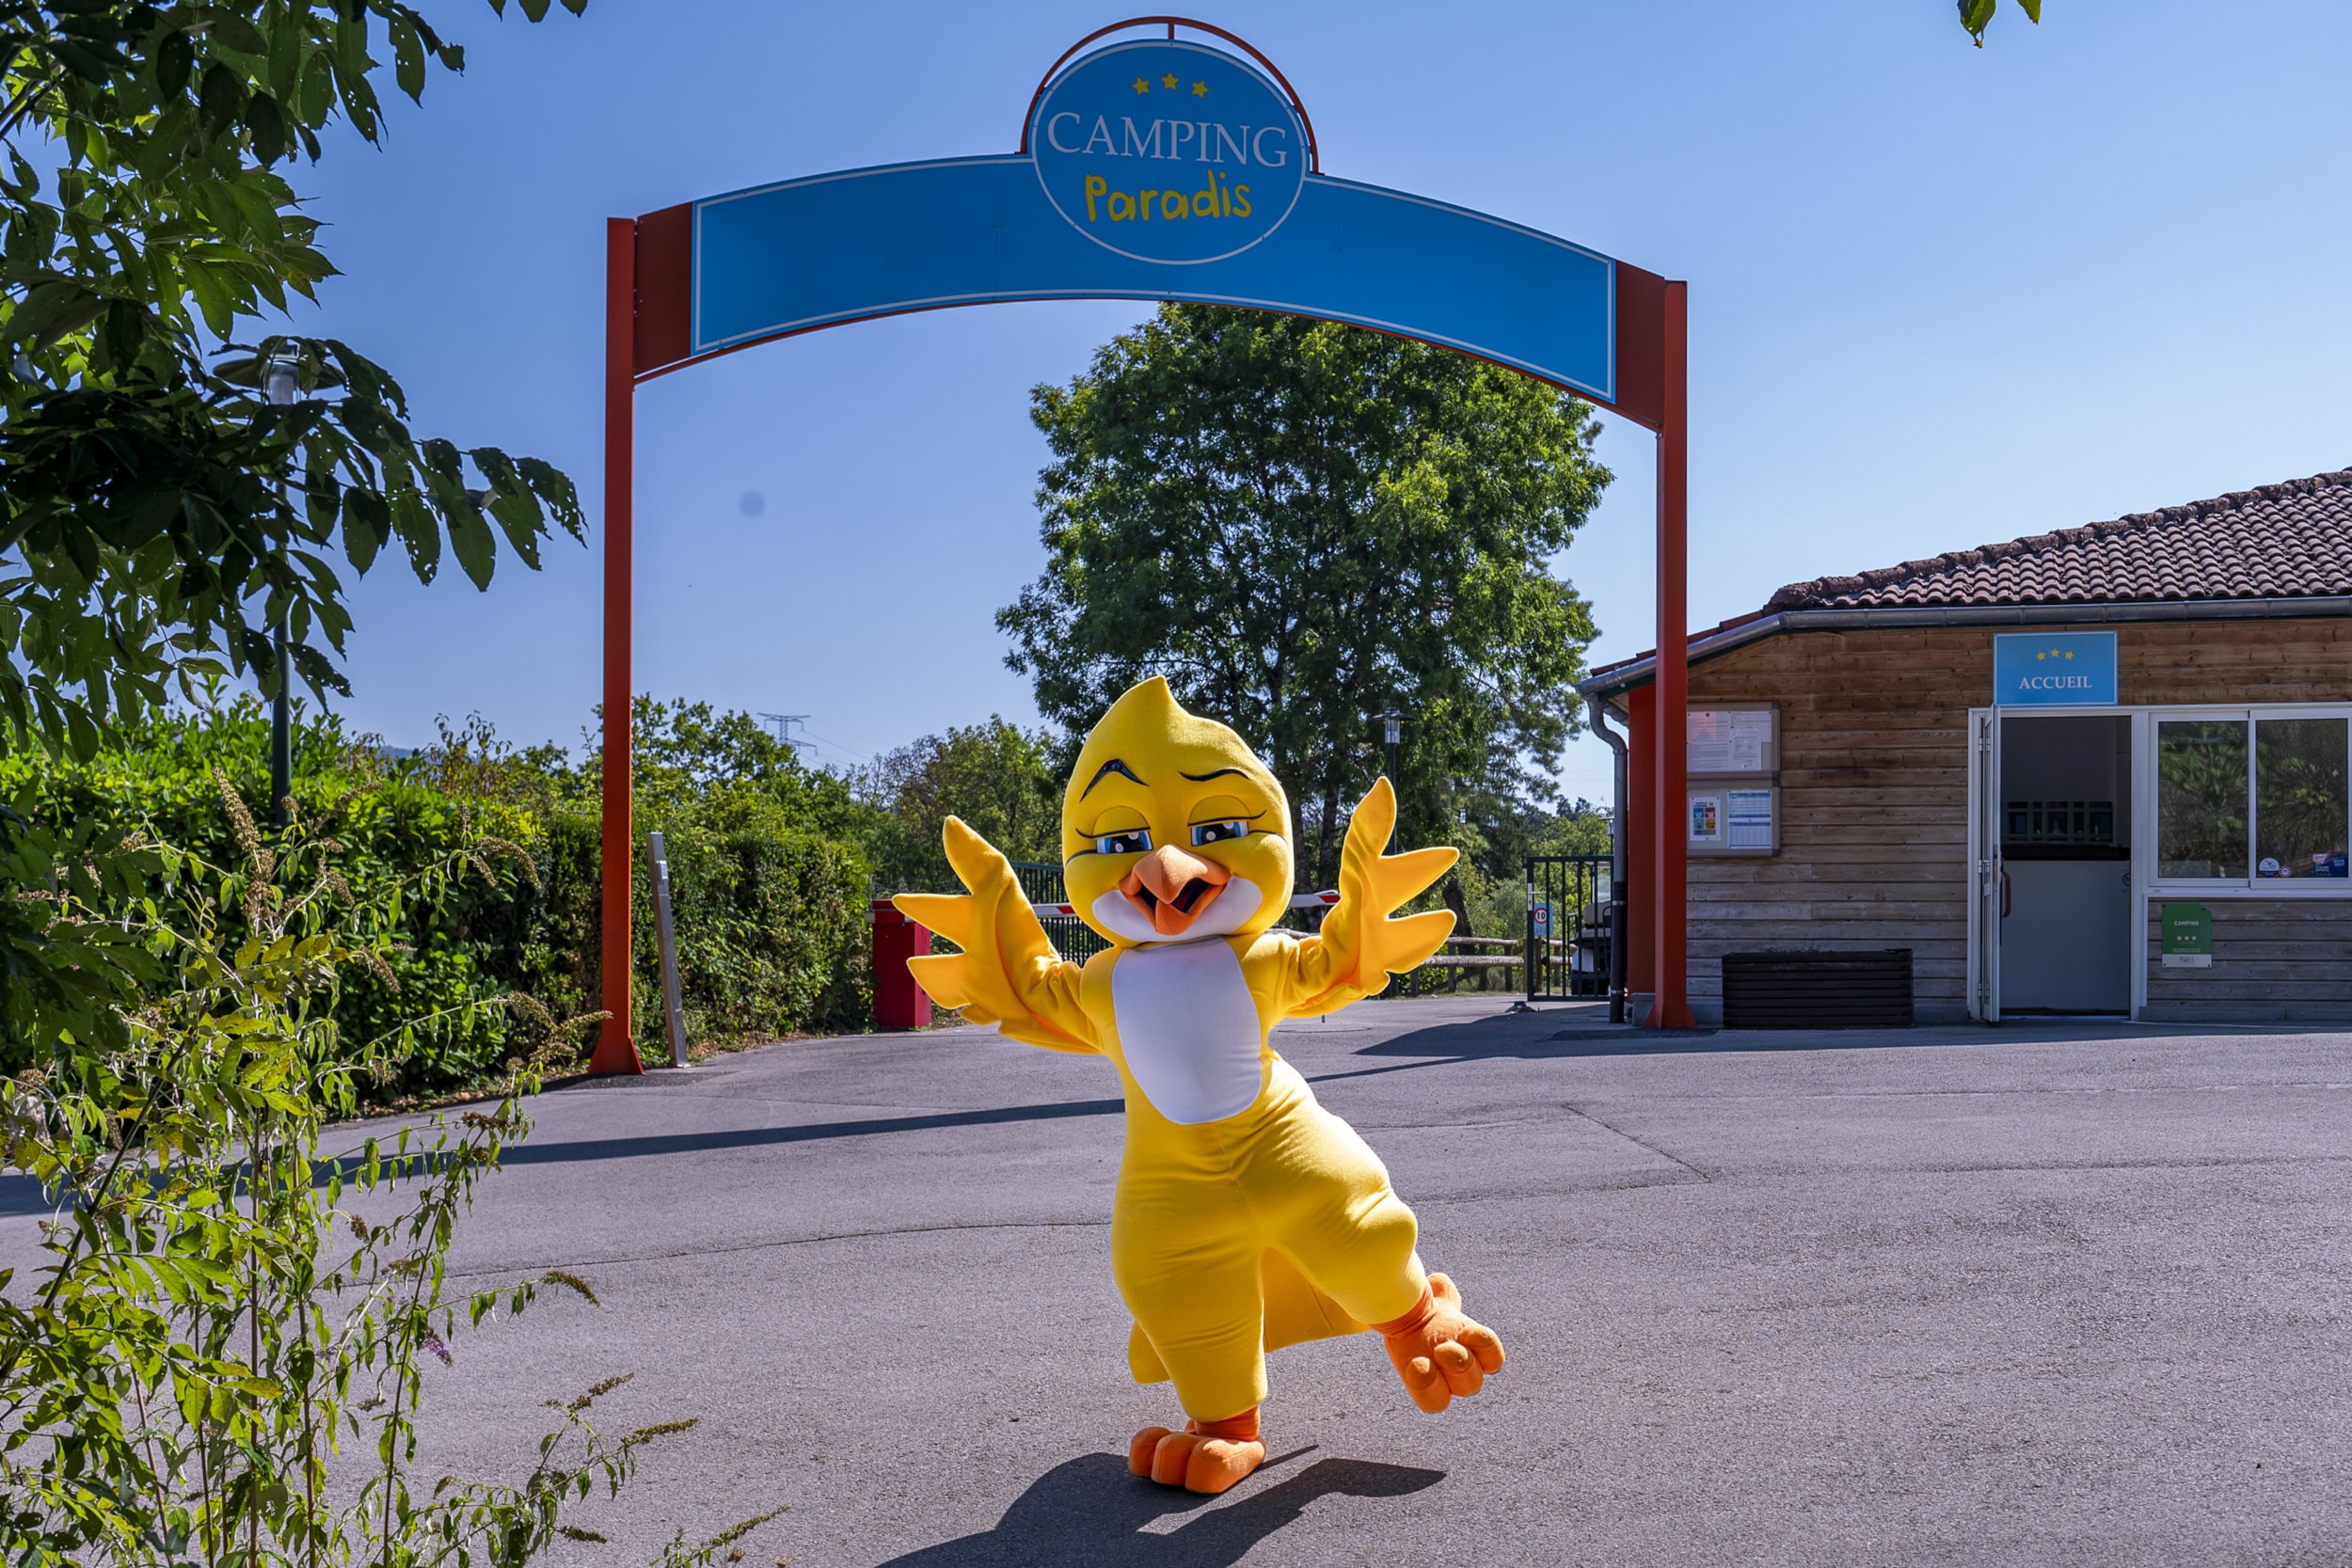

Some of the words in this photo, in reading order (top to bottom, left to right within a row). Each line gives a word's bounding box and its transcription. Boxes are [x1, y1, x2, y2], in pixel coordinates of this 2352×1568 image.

[1047, 111, 1288, 167] CAMPING
[1085, 168, 1252, 223] Paradis
[2018, 676, 2092, 689] ACCUEIL
